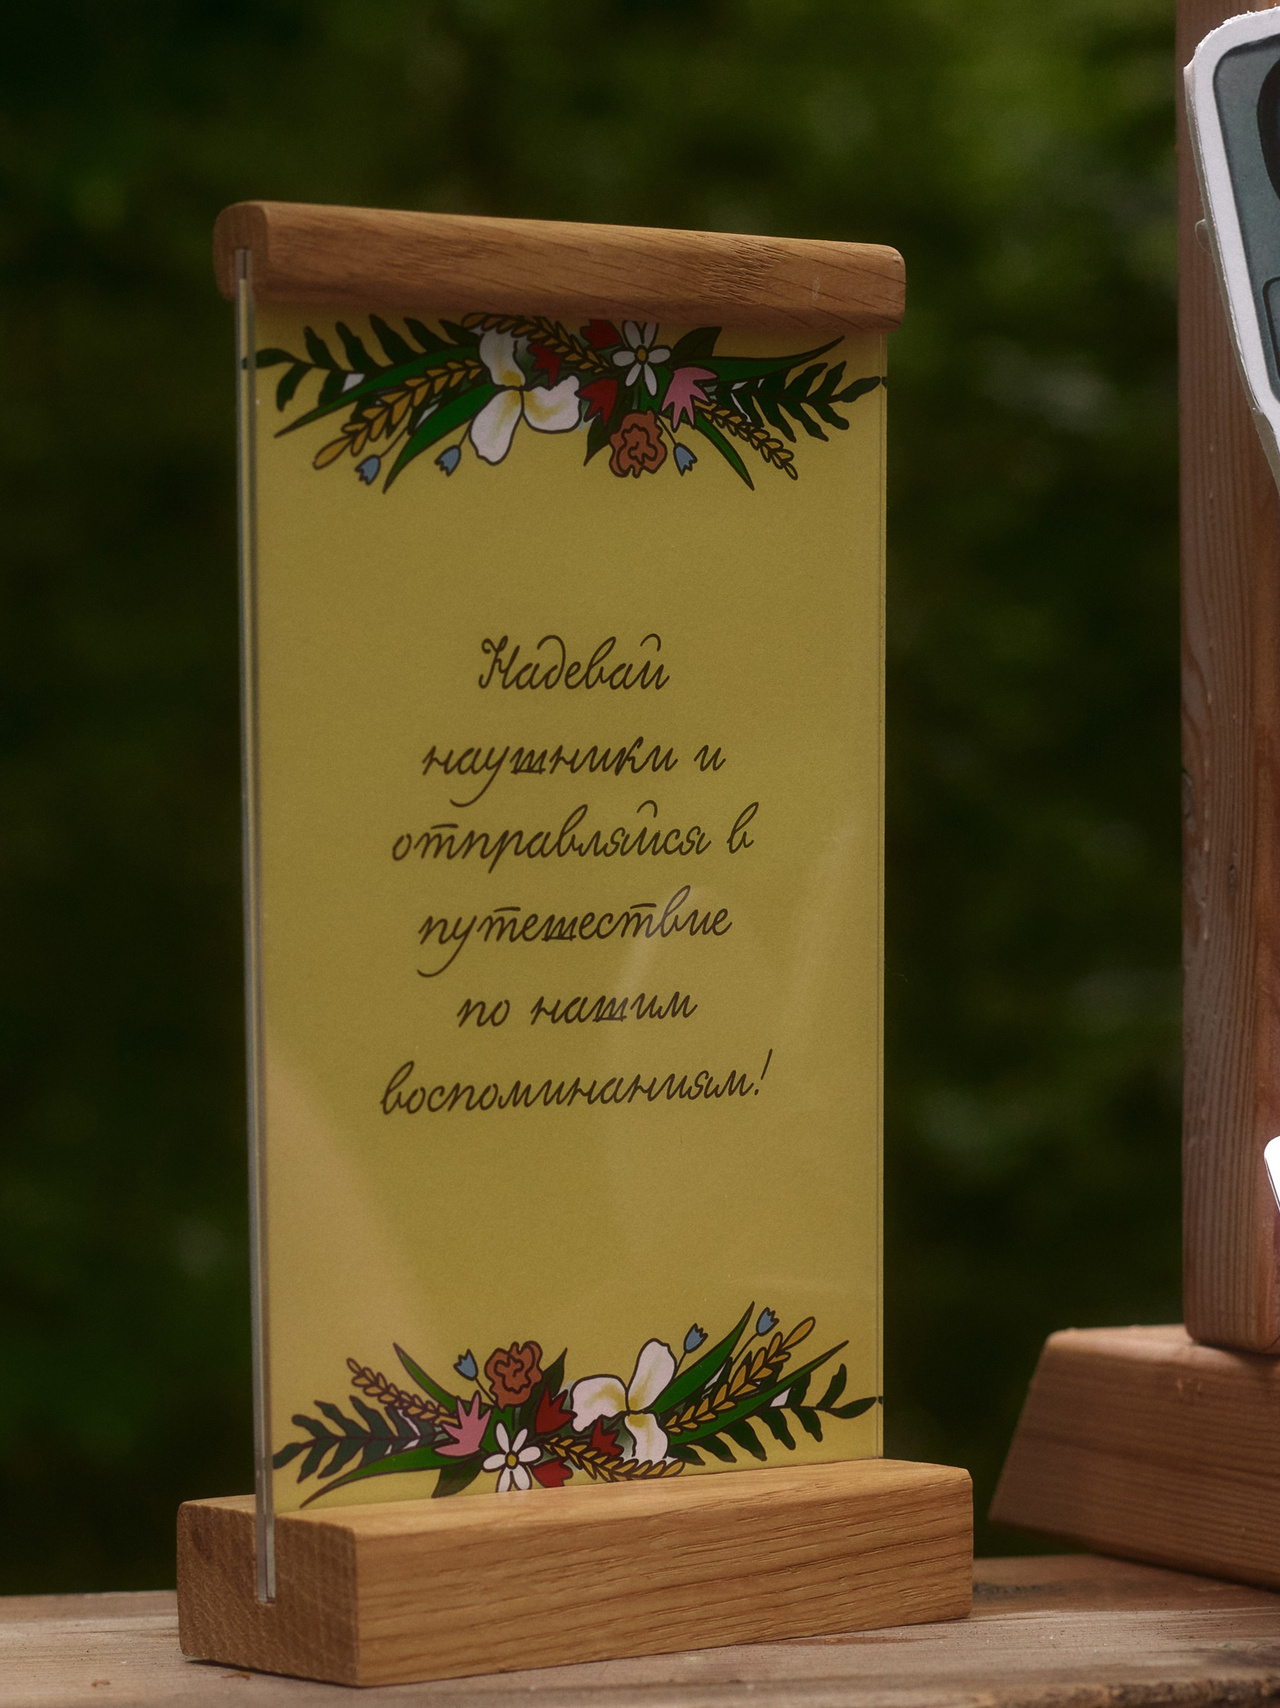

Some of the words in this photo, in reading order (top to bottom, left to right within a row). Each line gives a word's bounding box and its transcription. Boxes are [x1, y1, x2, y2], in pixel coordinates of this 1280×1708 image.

[478, 633, 670, 690] Надевай
[422, 736, 678, 807] наушники
[694, 744, 727, 772] и
[392, 800, 712, 874] отправляйся
[727, 801, 760, 855] в
[417, 884, 733, 978] путешествие
[456, 997, 510, 1028] по
[530, 991, 699, 1026] нашим
[380, 1048, 774, 1116] воспоминаниям!
